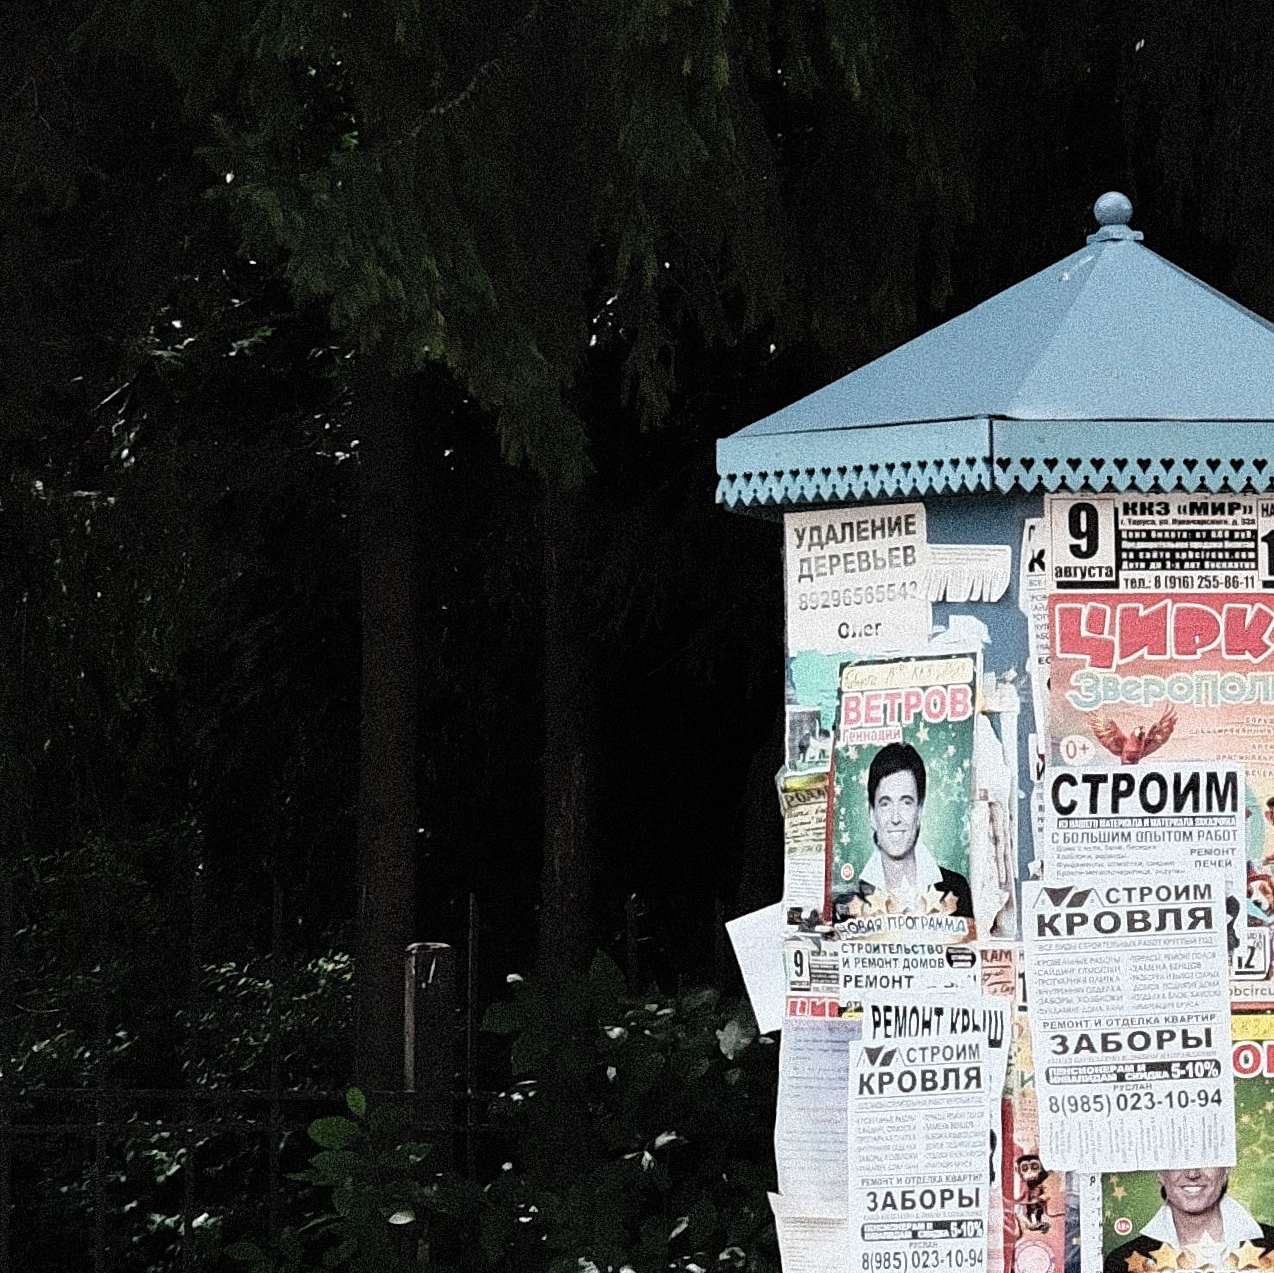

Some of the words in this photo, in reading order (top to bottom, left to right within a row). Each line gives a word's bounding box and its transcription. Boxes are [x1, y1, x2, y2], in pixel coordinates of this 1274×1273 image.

[1123, 501, 1170, 516] ККЗ
[793, 513, 917, 552] УДАЛЕНИЕ
[1068, 502, 1099, 559] 9
[798, 544, 917, 583] ДЕРЕВЬЕВ
[1054, 566, 1114, 580] августа
[1155, 575, 1162, 589] 8
[1165, 575, 1194, 589] (916)
[1197, 575, 1255, 589] 255-86-11
[843, 686, 973, 727] ВЕТРОВ
[842, 727, 901, 745] Геннадий
[1065, 736, 1091, 760] 0+
[1051, 771, 1239, 816] СТРОИМ
[1051, 831, 1059, 844] С
[1063, 831, 1131, 844] БОЛЬШИМ
[1136, 830, 1193, 843] ОПЫТОМ
[1197, 829, 1238, 842] РАБОТ
[1190, 848, 1237, 857] РЕМОНТ
[1194, 859, 1233, 869] ПЕЧЕЙ
[1105, 883, 1213, 905] СТРОИМ
[838, 919, 883, 938] НОВАЯ
[888, 916, 967, 933] ПРОГРАММА
[1036, 906, 1213, 938] КРОВЛЯ
[841, 943, 944, 956] СТРОИТЕЛЬСТВО
[793, 949, 804, 978] 9
[842, 958, 850, 969] И
[854, 958, 899, 969] РЕМОНТ
[902, 958, 945, 971] ДОМОВ
[843, 974, 914, 990] РЕМОНТ
[871, 1004, 945, 1040] РЕМОНТ
[1042, 1019, 1090, 1030] РЕМОНТ
[1094, 1018, 1102, 1028] И
[1106, 1016, 1160, 1028] ОТДЕЛКА
[1164, 1013, 1216, 1025] КВАРТИР
[1050, 1027, 1212, 1056] ЗАБОРЫ
[906, 1043, 980, 1064] СТРОИМ
[858, 1066, 982, 1096] КРОВЛЯ
[1048, 1064, 1135, 1076] ПЕНСИОНЕРАМ
[1170, 1061, 1220, 1079] 5-10%
[1113, 1083, 1153, 1092] РУСЛАН
[1048, 1093, 1112, 1118] 8(985)
[1116, 1088, 1223, 1112] 023-10-94
[866, 1187, 980, 1212] ЗАБОРЫ
[911, 1247, 984, 1270] 023-10-94
